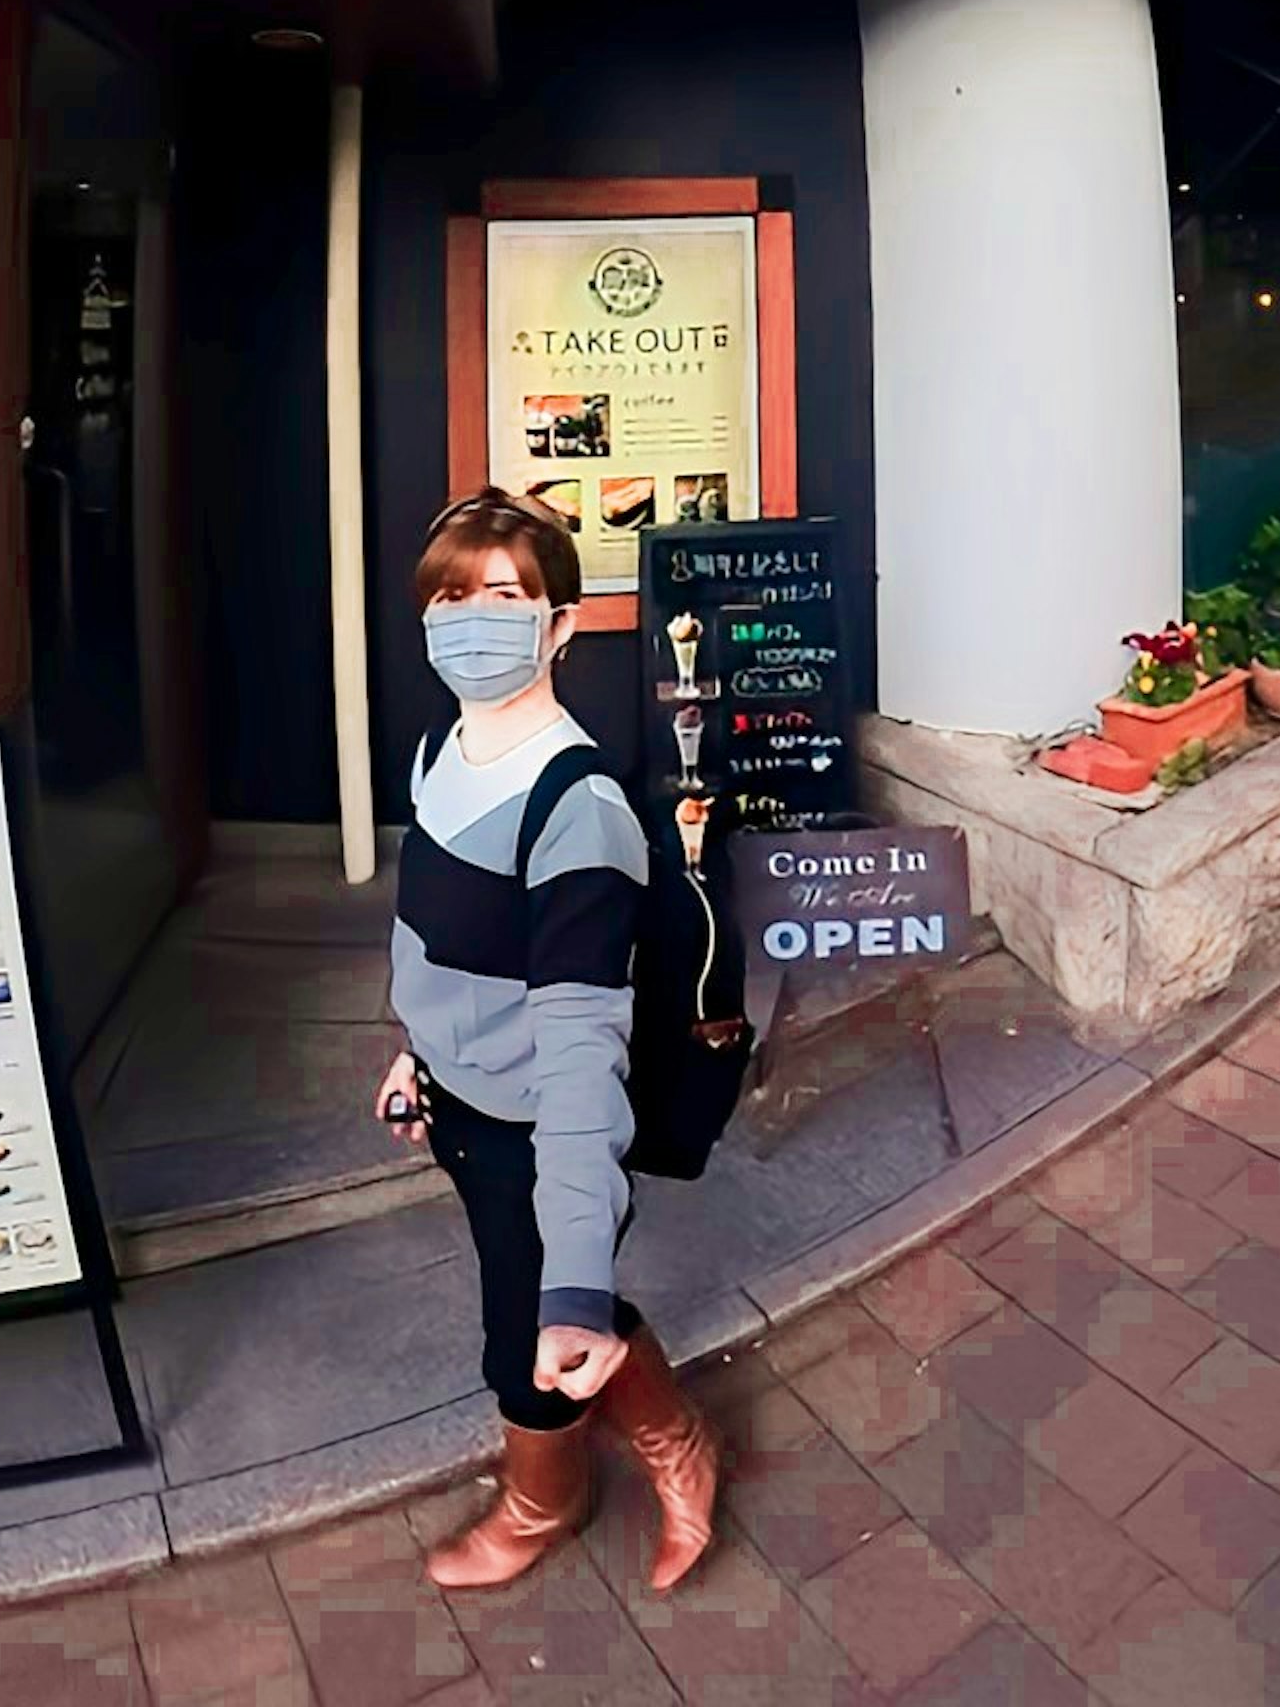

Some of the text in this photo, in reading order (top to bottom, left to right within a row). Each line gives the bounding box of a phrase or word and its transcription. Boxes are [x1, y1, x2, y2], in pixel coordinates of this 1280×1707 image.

[540, 326, 706, 355] TAKE OUT
[767, 845, 928, 880] Come In
[762, 913, 946, 962] OPEN
